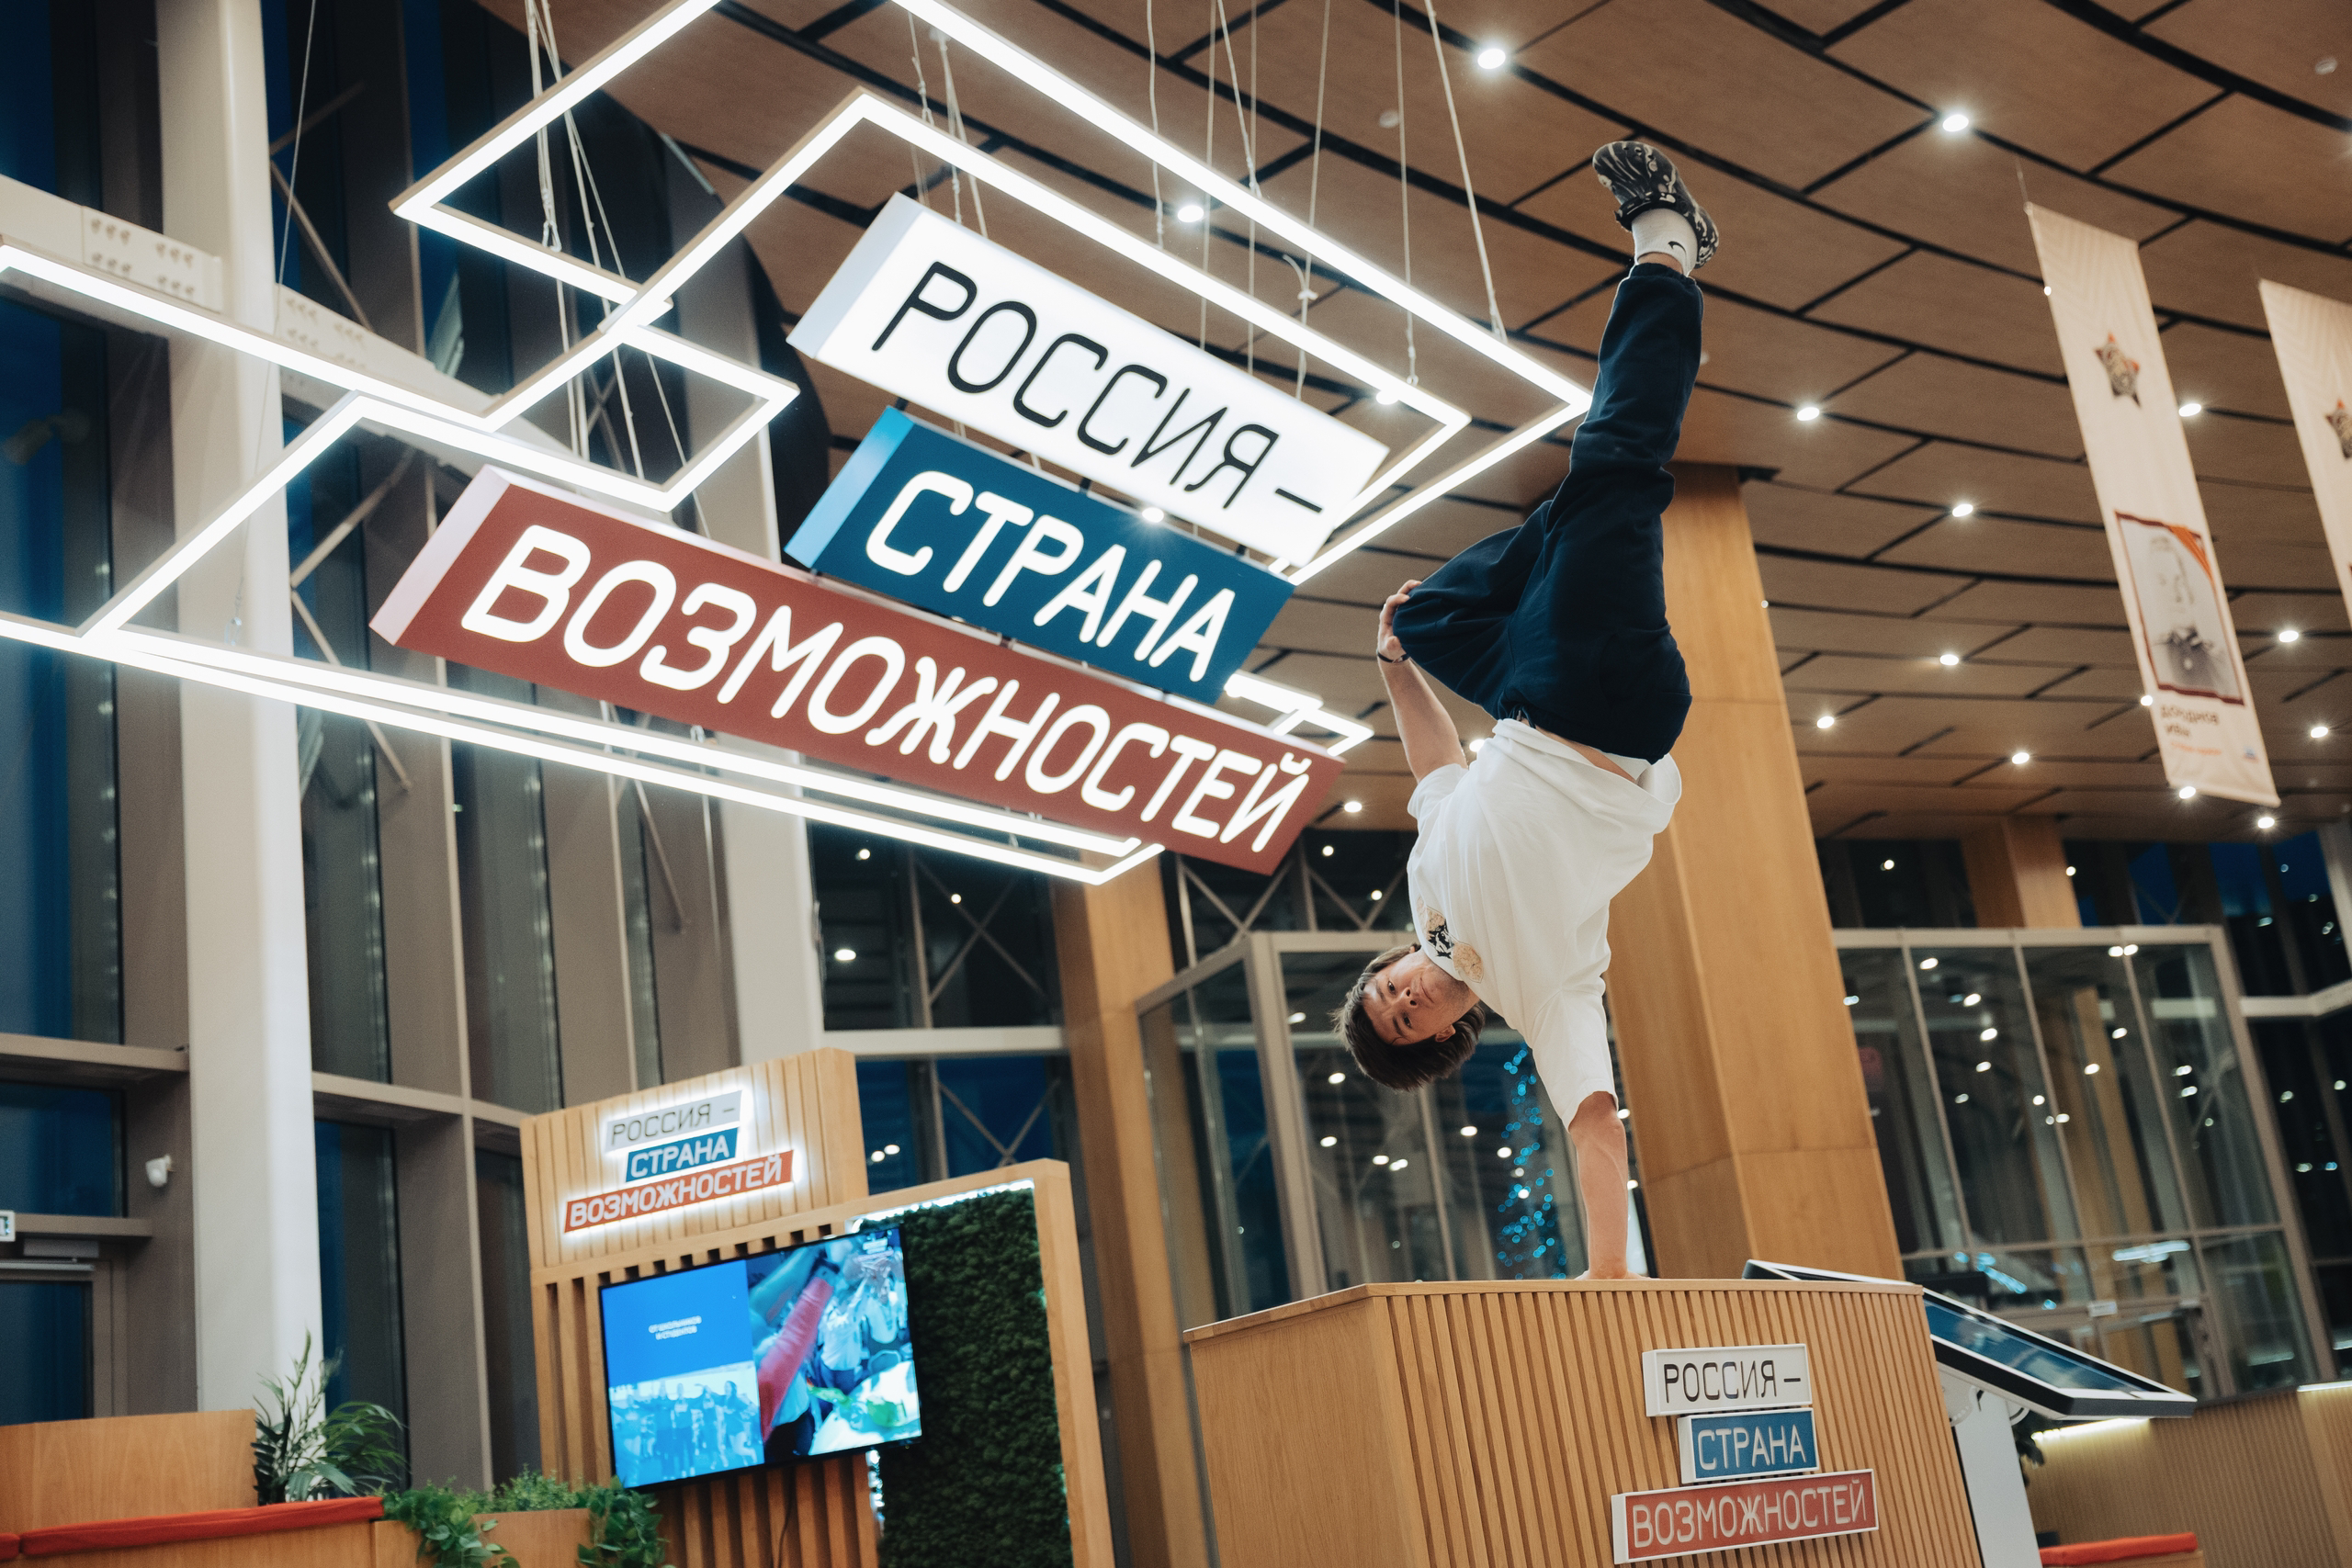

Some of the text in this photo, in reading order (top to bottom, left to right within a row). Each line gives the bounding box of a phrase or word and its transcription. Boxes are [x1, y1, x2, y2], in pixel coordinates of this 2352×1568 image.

[872, 260, 1282, 510] РОССИЯ
[865, 469, 1238, 683] СТРАНА
[460, 525, 1312, 854] ВОЗМОЖНОСТЕЙ
[611, 1103, 711, 1146] РОССИЯ
[630, 1134, 729, 1179] СТРАНА
[570, 1154, 782, 1228] ВОЗМОЖНОСТЕЙ
[1663, 1359, 1777, 1404] РОССИЯ
[1698, 1424, 1807, 1472] СТРАНА
[1632, 1479, 1867, 1549] ВОЗМОЖНОСТЕЙ
